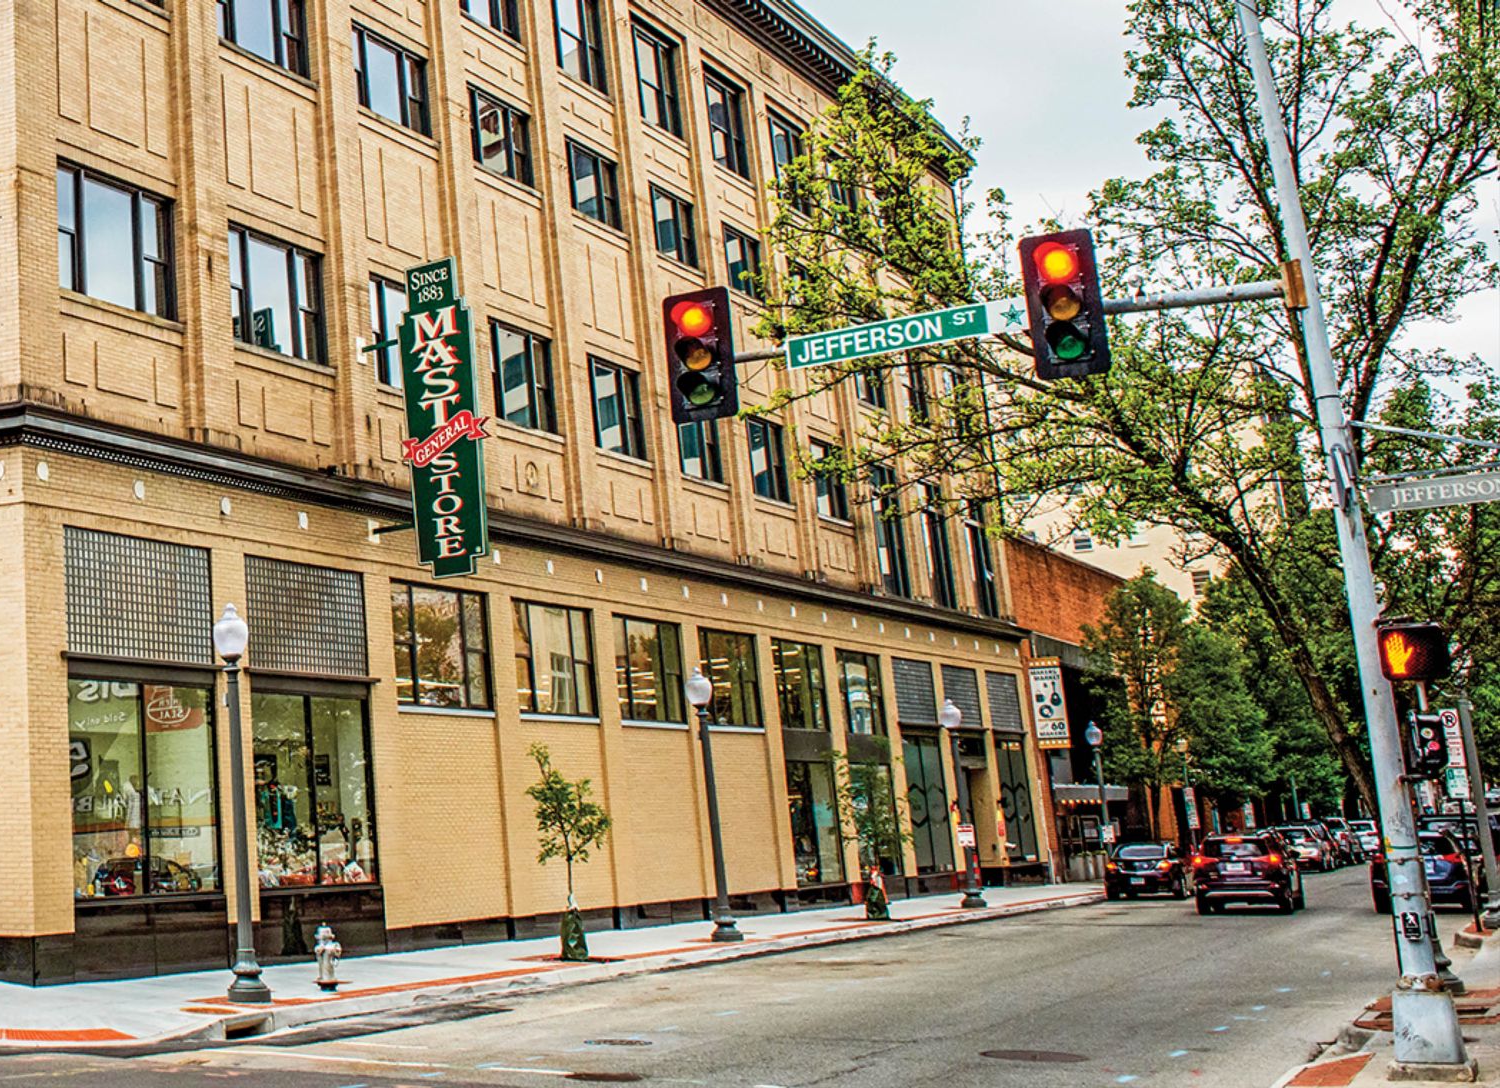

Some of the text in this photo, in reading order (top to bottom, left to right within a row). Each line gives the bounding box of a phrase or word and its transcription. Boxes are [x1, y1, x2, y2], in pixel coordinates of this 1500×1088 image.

[410, 267, 449, 291] SINCE
[418, 285, 445, 304] 1883
[797, 309, 976, 364] JEFFERSON ST
[409, 304, 461, 430] MAST
[415, 415, 469, 463] GENERAL
[429, 451, 467, 559] STORE
[1051, 721, 1066, 731] 60
